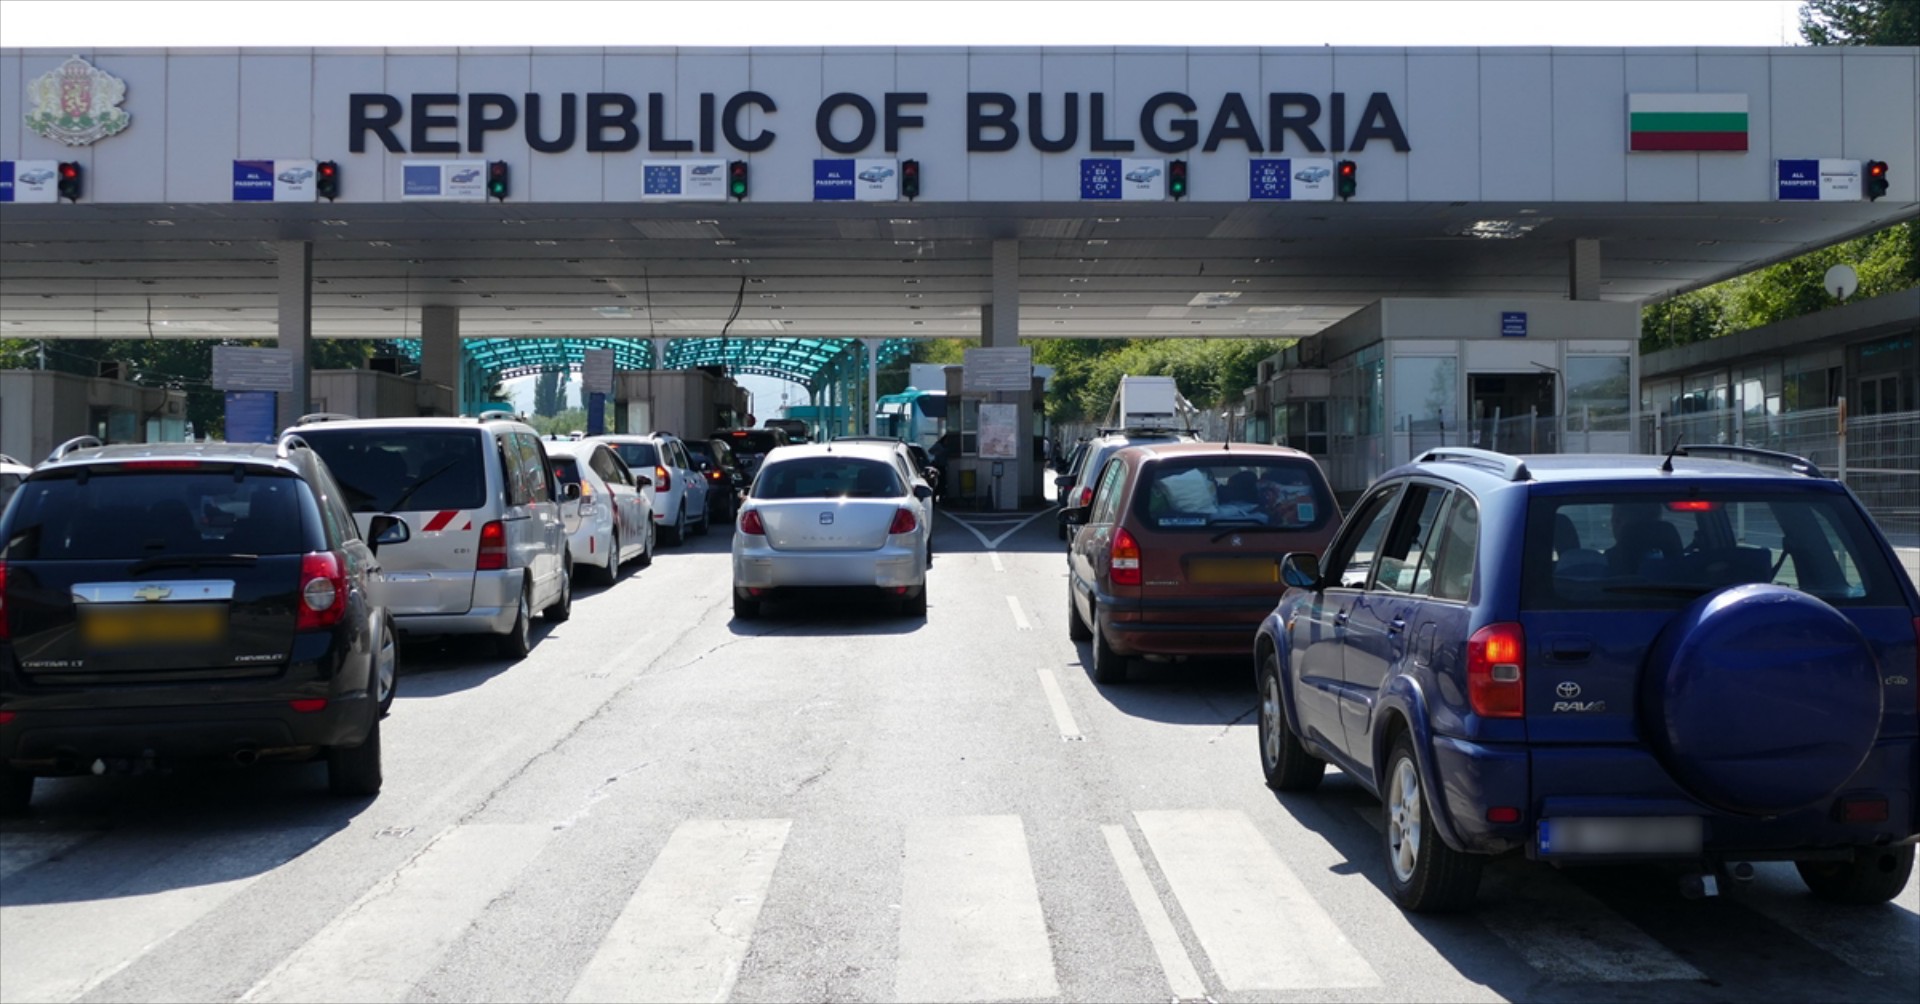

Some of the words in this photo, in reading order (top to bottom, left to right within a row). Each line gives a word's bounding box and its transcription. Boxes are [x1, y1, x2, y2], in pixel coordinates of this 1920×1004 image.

[349, 91, 778, 154] REPUBLIC
[815, 92, 929, 154] OF
[966, 91, 1412, 154] BULGARIA
[1552, 701, 1606, 712] RAV4
